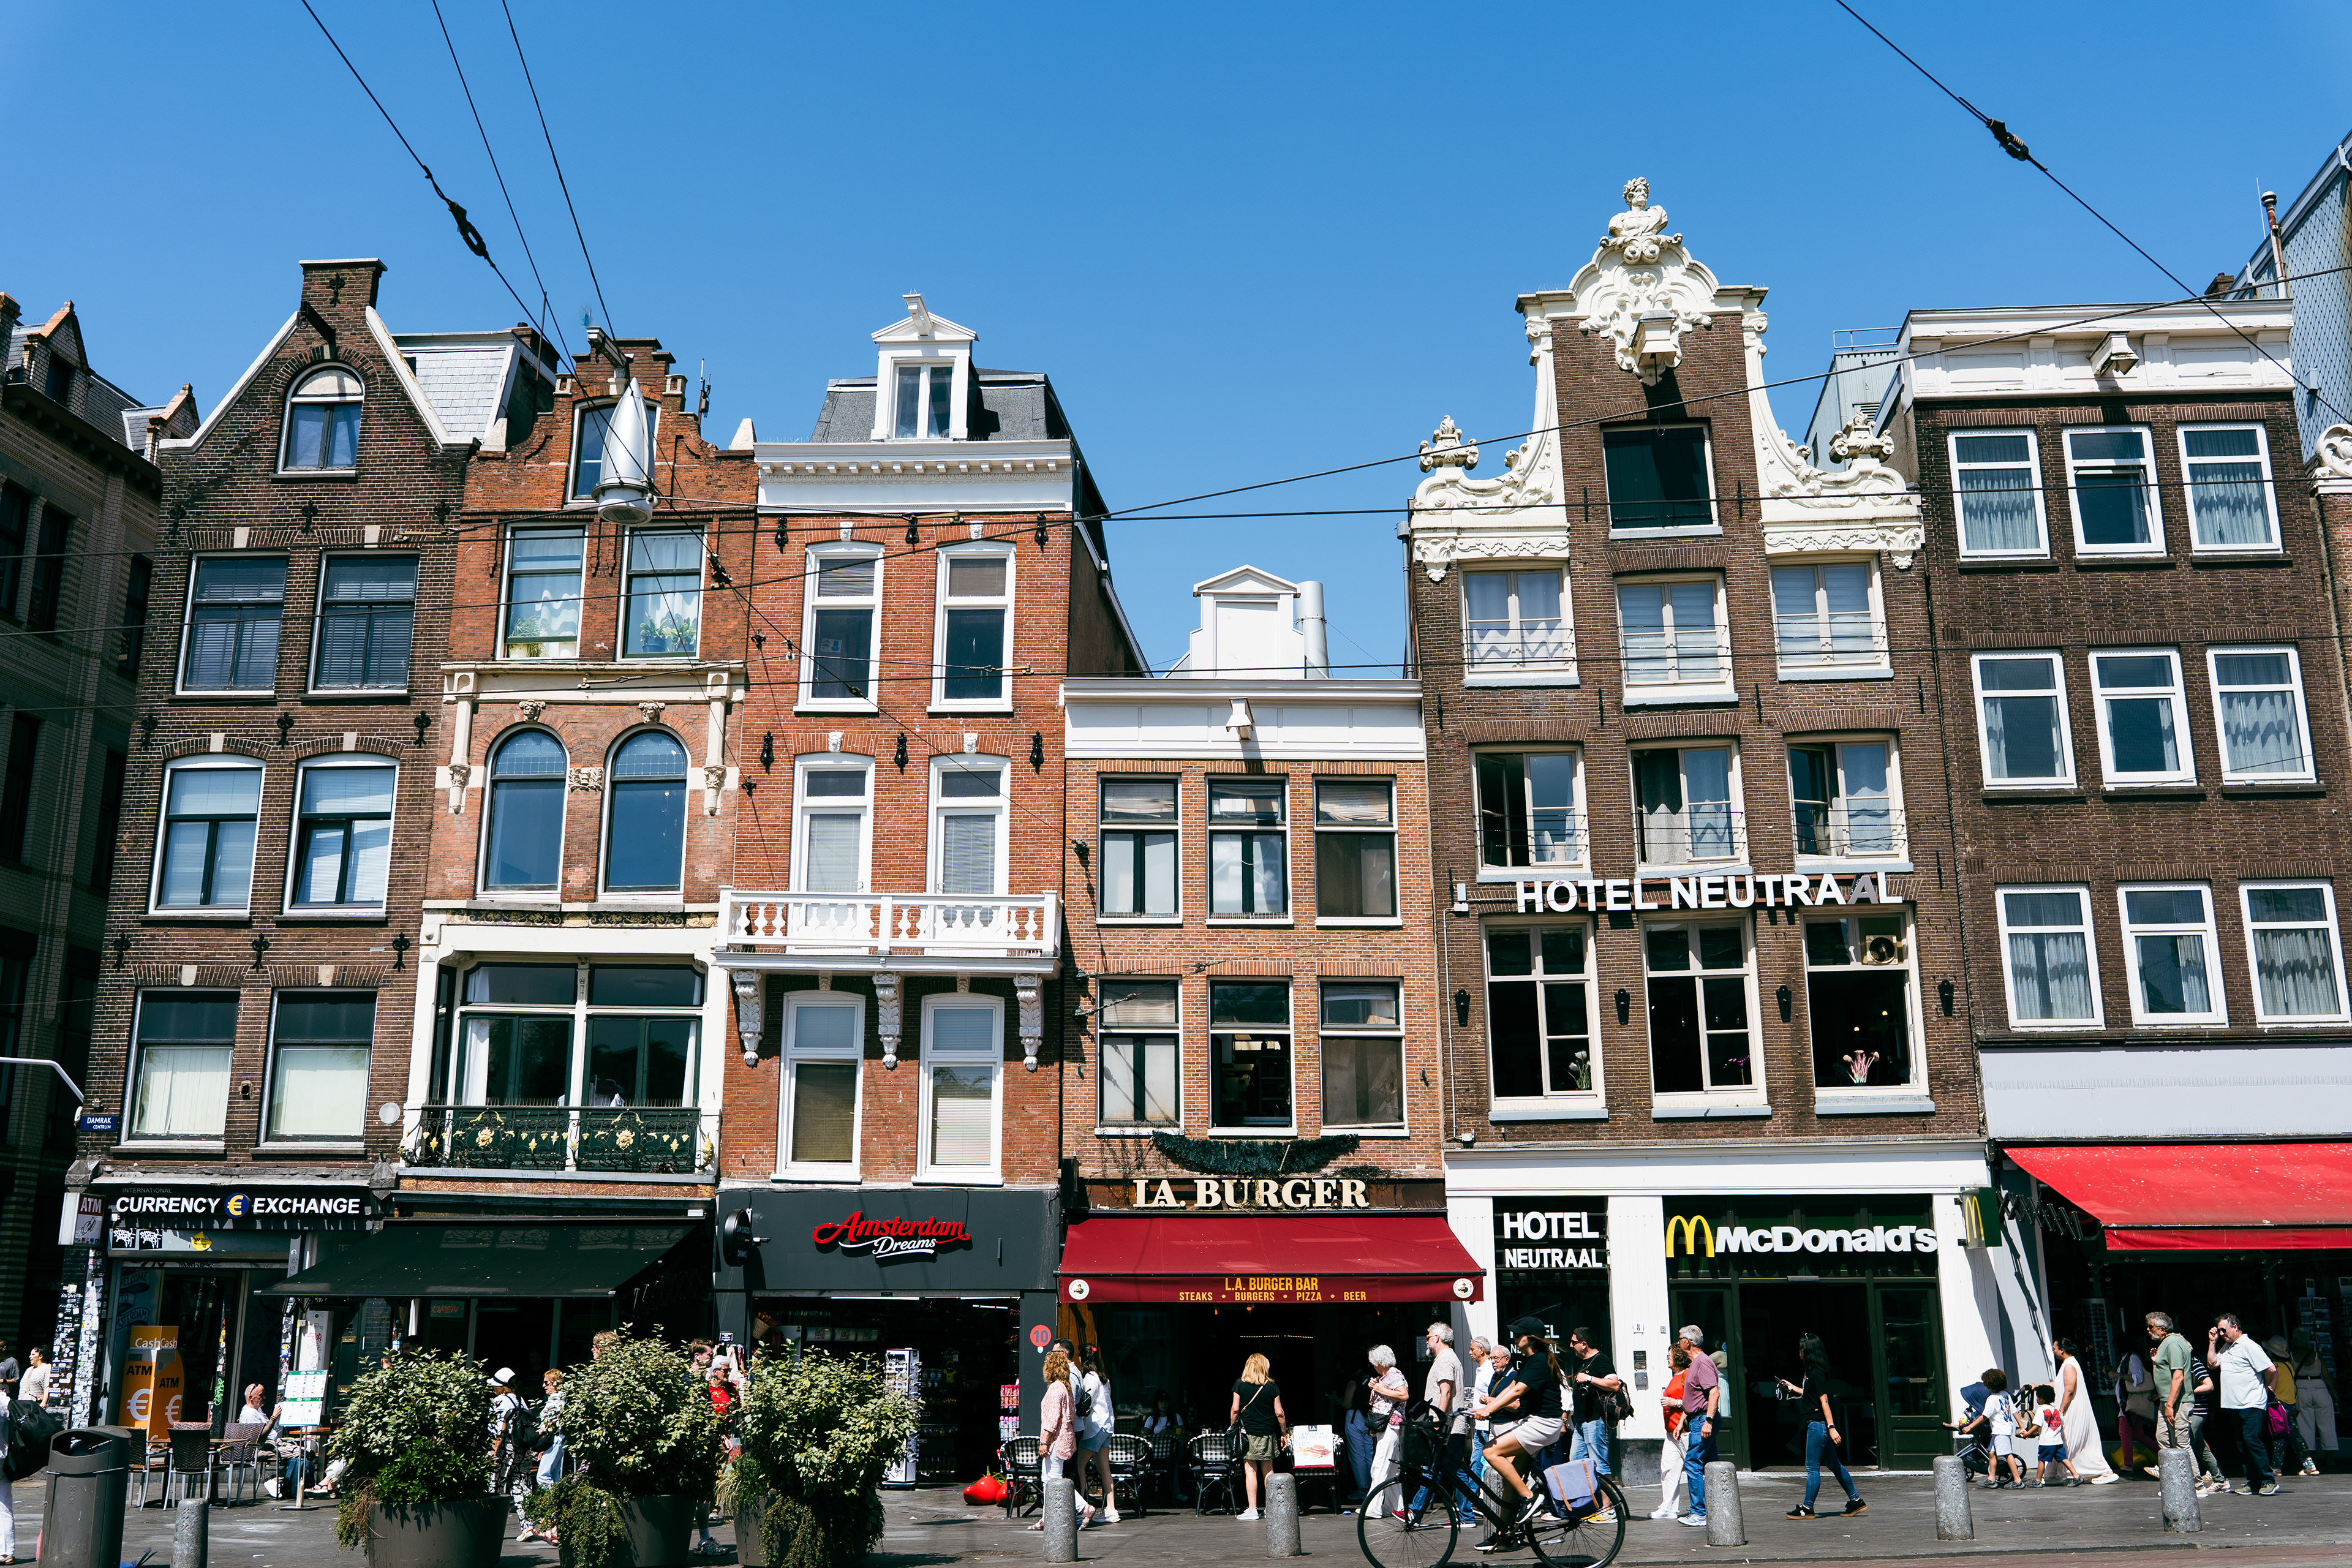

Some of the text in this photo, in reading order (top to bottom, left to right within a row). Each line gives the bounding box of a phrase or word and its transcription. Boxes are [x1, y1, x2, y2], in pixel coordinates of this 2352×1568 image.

[1516, 871, 1903, 913] HOTEL NEUTRAAL
[1194, 1178, 1370, 1208] BURGER
[80, 1197, 102, 1214] ATM
[116, 1197, 221, 1213] CURRENCY
[252, 1197, 360, 1214] EXCHANGE
[812, 1211, 971, 1244] Amsterdam
[1503, 1211, 1600, 1240] HOTEL
[871, 1236, 937, 1257] Dreams
[1715, 1225, 1938, 1253] McDonald's
[1504, 1248, 1603, 1268] NEUTRAAL
[1225, 1277, 1318, 1291] L.A. BURGER BAR
[1179, 1291, 1366, 1301] STEAKS BURGERS PIZZA BEER
[432, 1305, 459, 1314] OPEN
[135, 1337, 160, 1348] Cash
[160, 1337, 178, 1348] Cash
[1033, 1329, 1049, 1343] 10
[126, 1365, 153, 1376] ATM
[159, 1378, 179, 1389] ATM
